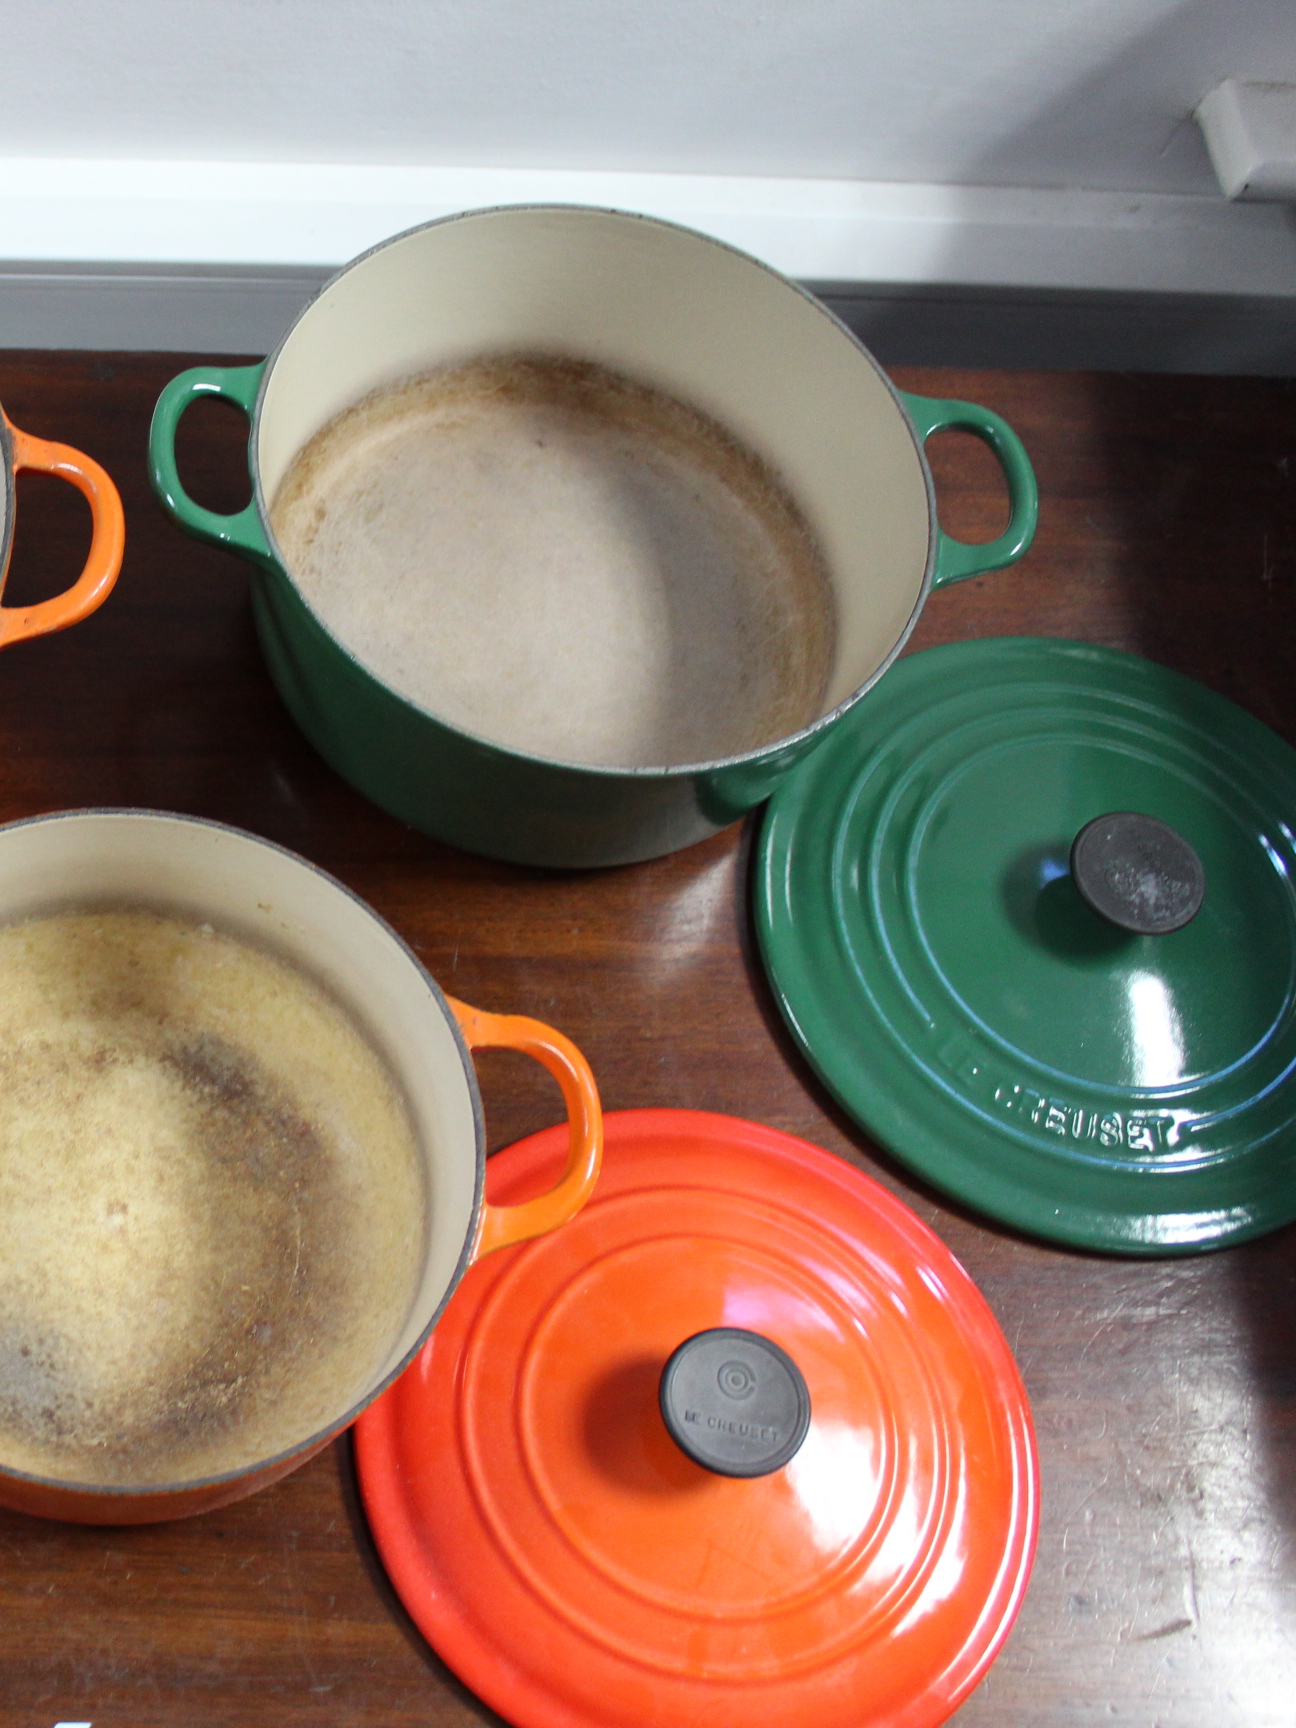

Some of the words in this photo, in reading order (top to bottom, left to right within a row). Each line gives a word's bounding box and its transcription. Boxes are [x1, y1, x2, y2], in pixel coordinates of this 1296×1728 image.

[992, 1081, 1186, 1151] CREUSET
[684, 1409, 701, 1425] LE
[707, 1416, 778, 1442] CREUSET
